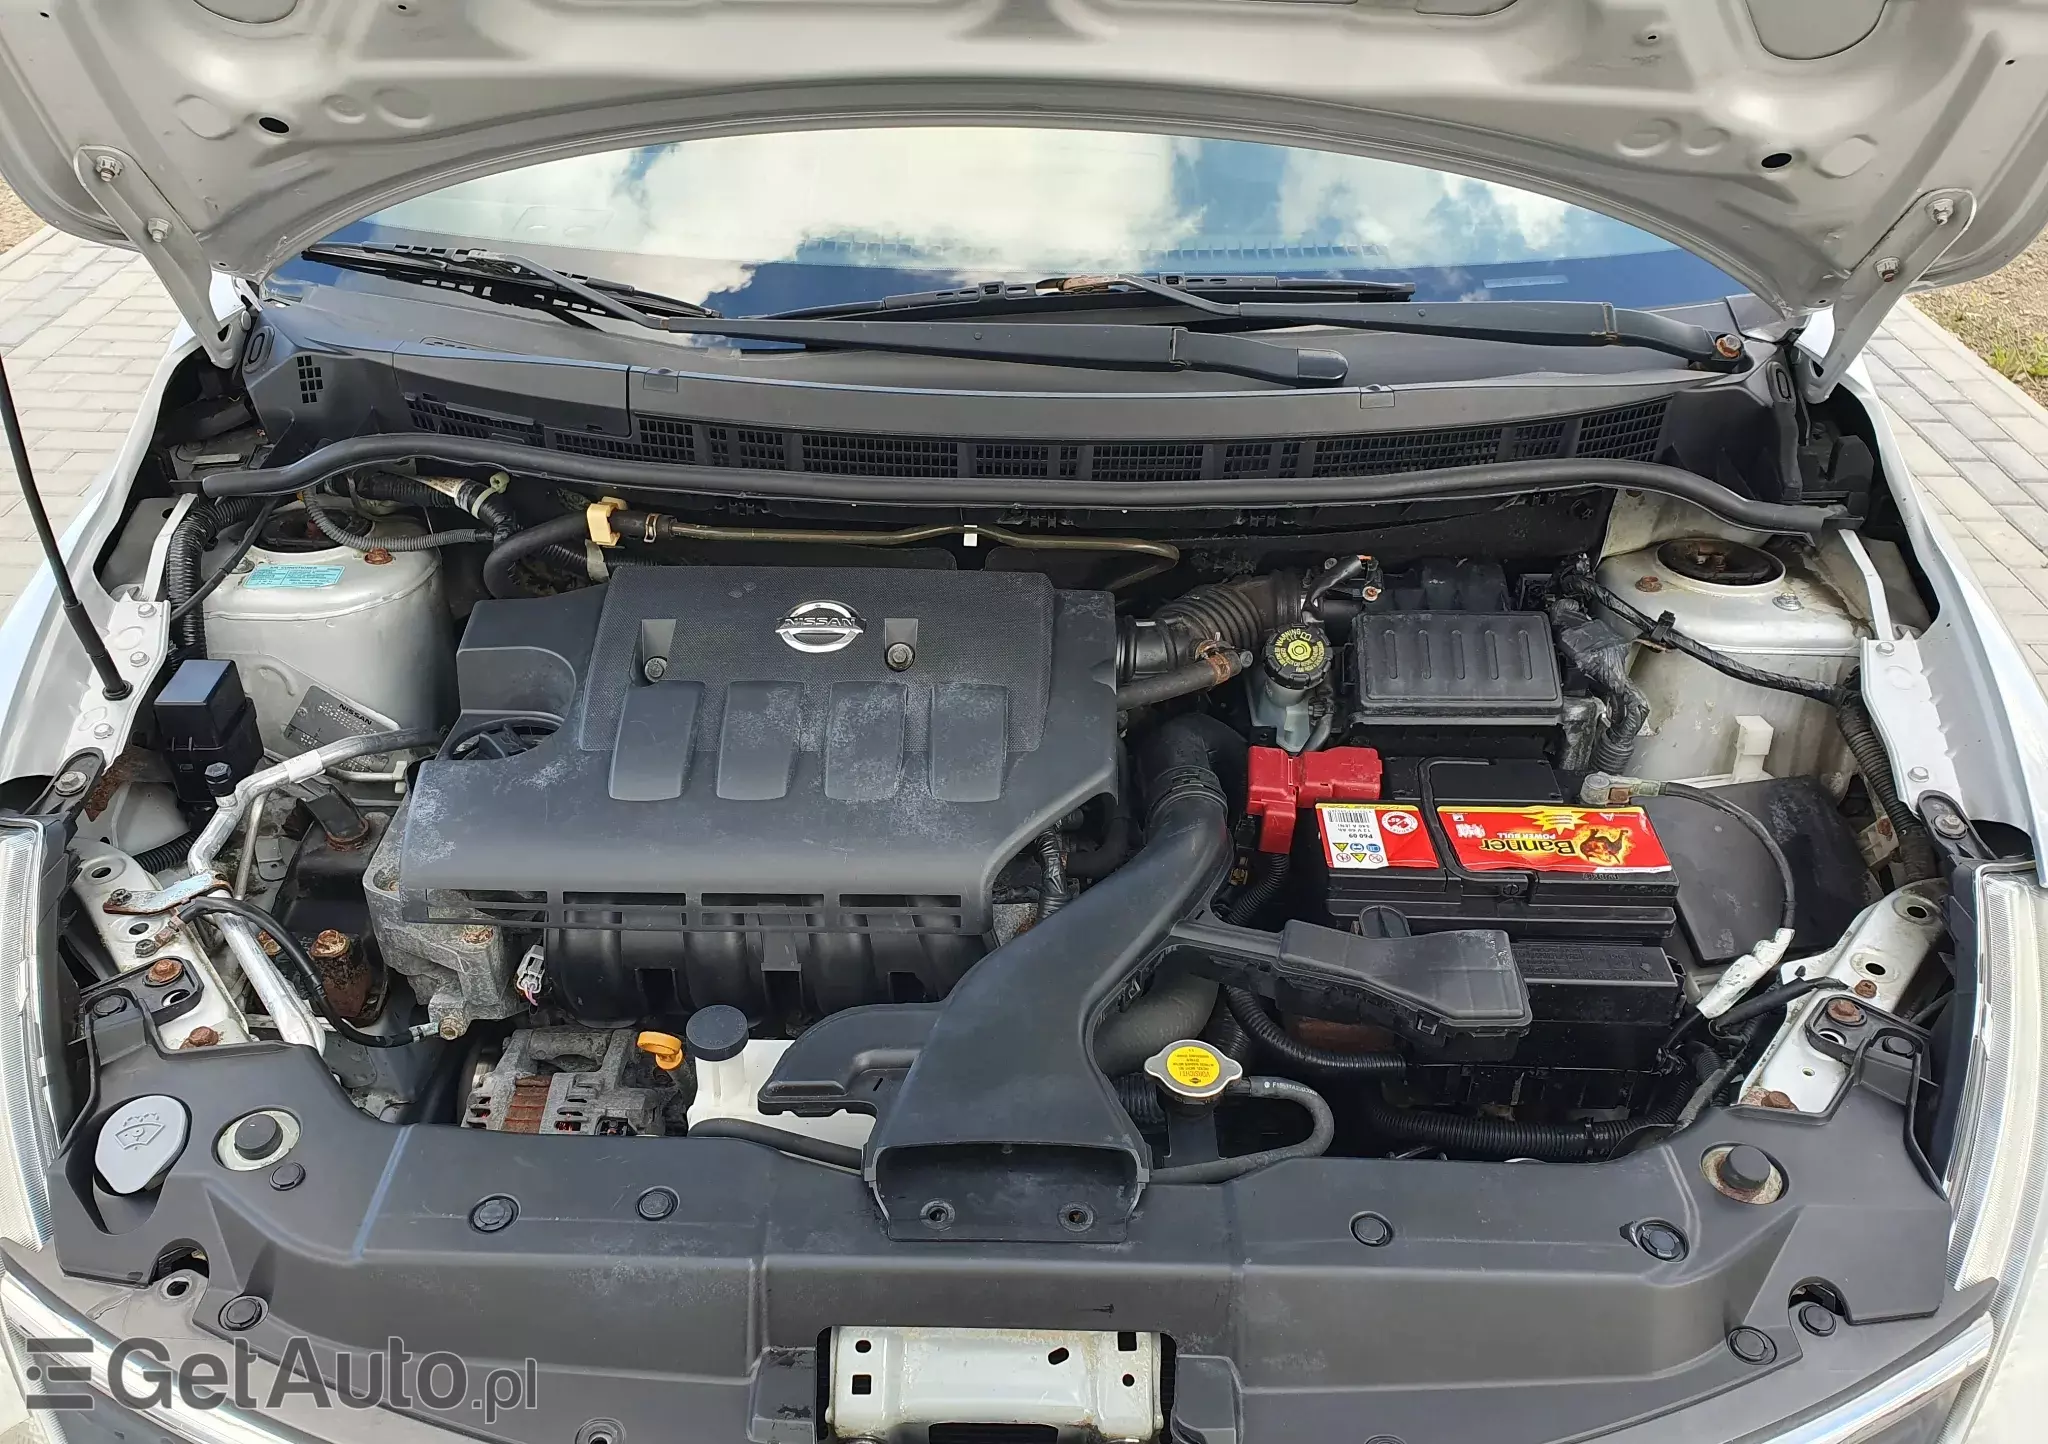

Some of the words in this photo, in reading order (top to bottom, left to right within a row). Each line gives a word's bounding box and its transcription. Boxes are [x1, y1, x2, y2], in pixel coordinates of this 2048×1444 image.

[1275, 628, 1301, 646] WARNING
[339, 703, 373, 725] NISSAN
[1522, 832, 1556, 840] POWER
[1480, 839, 1576, 855] Banner
